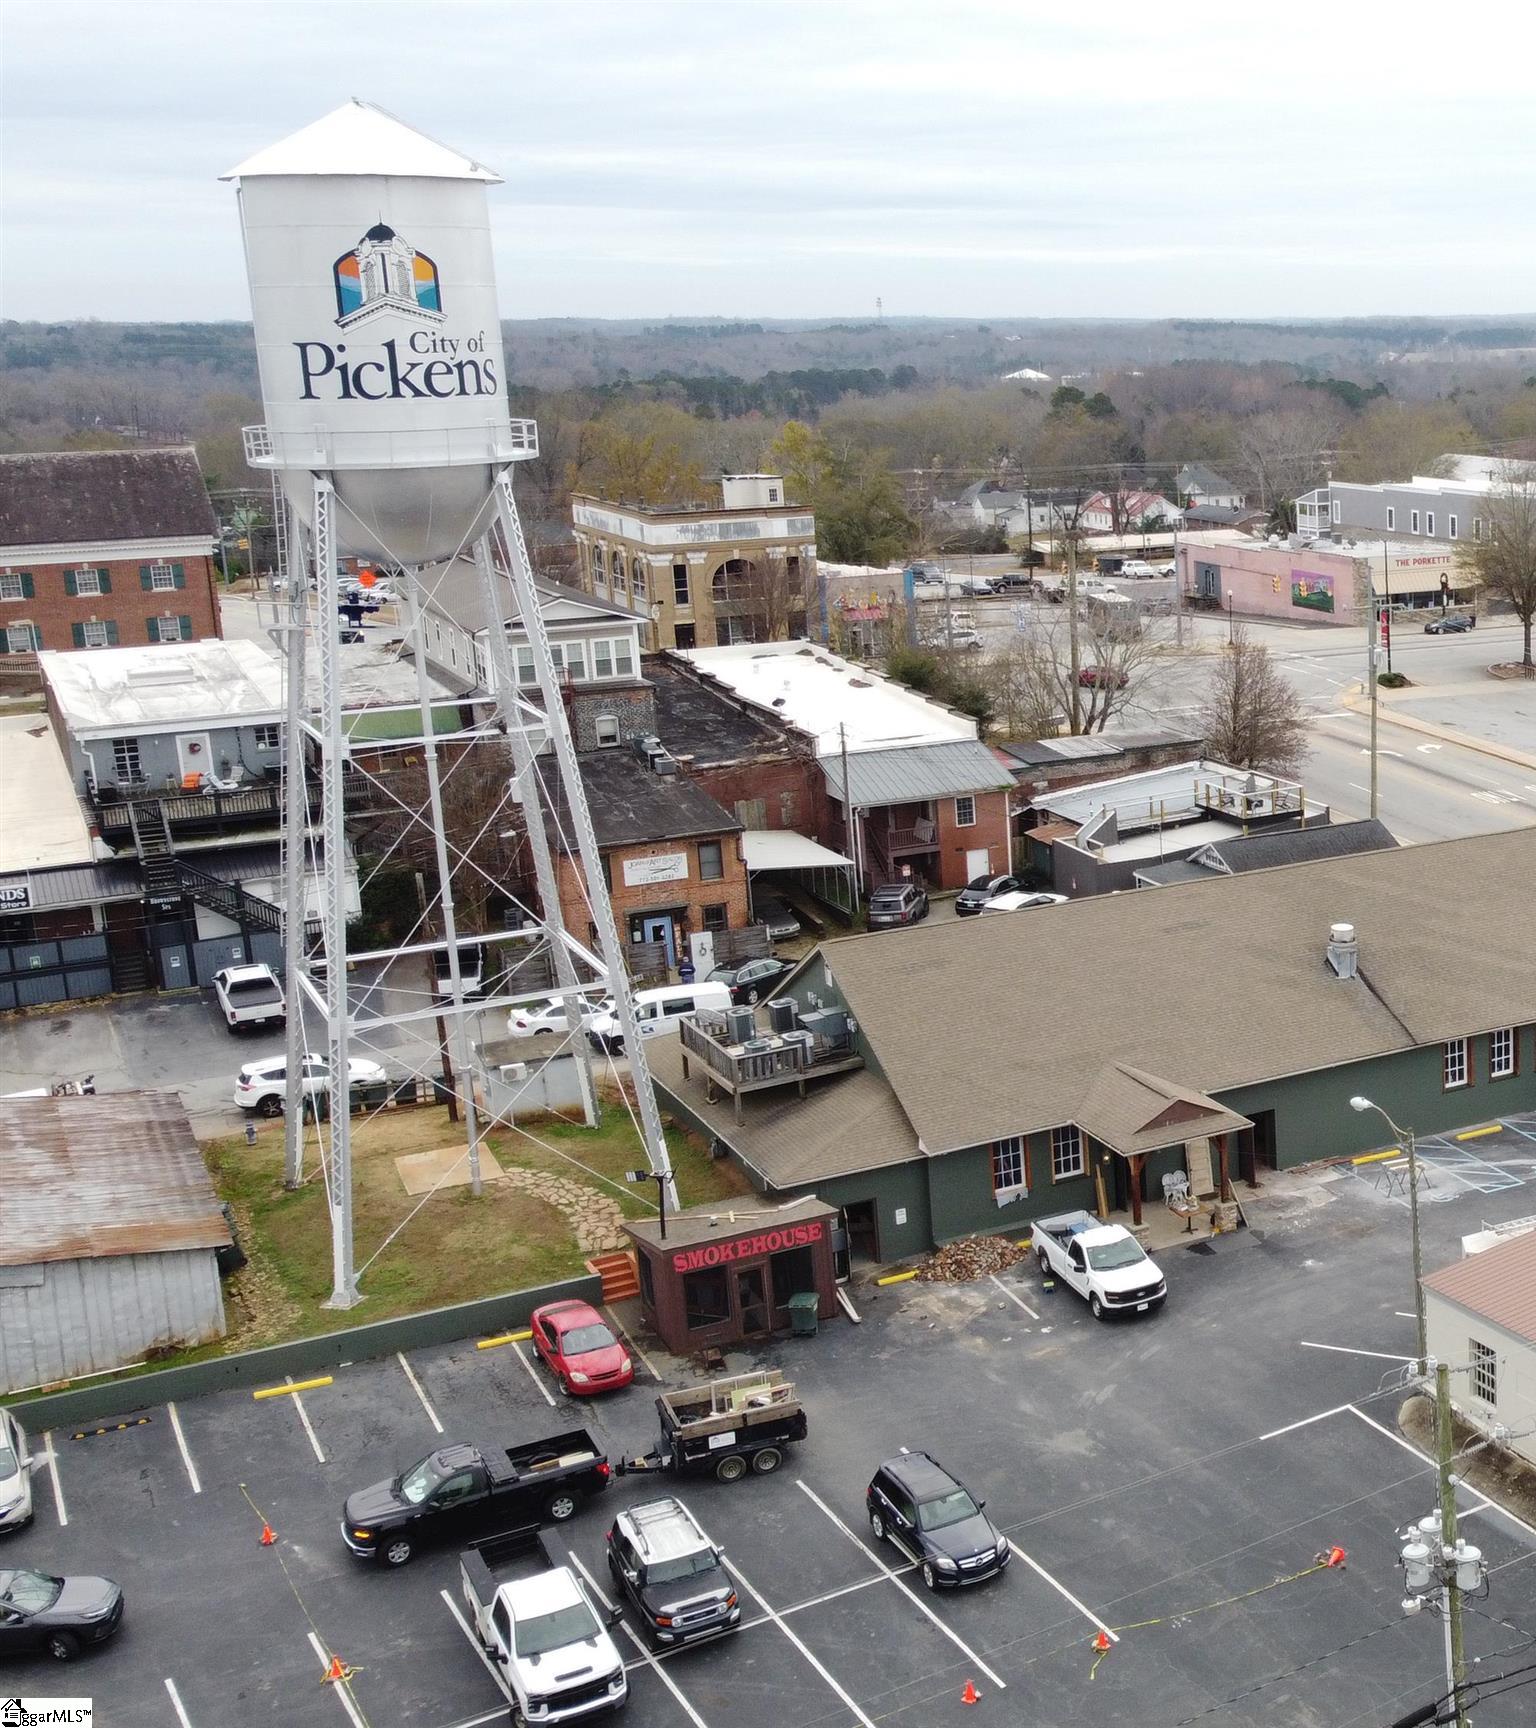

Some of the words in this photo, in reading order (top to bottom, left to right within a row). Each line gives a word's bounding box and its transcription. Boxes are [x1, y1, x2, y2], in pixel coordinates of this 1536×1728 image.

[409, 331, 460, 360] City
[467, 330, 485, 353] of
[293, 339, 498, 400] Pickens
[1395, 559, 1410, 567] THE
[1412, 556, 1451, 566] PORKETTE
[672, 1222, 822, 1273] SMOKEHOUSE
